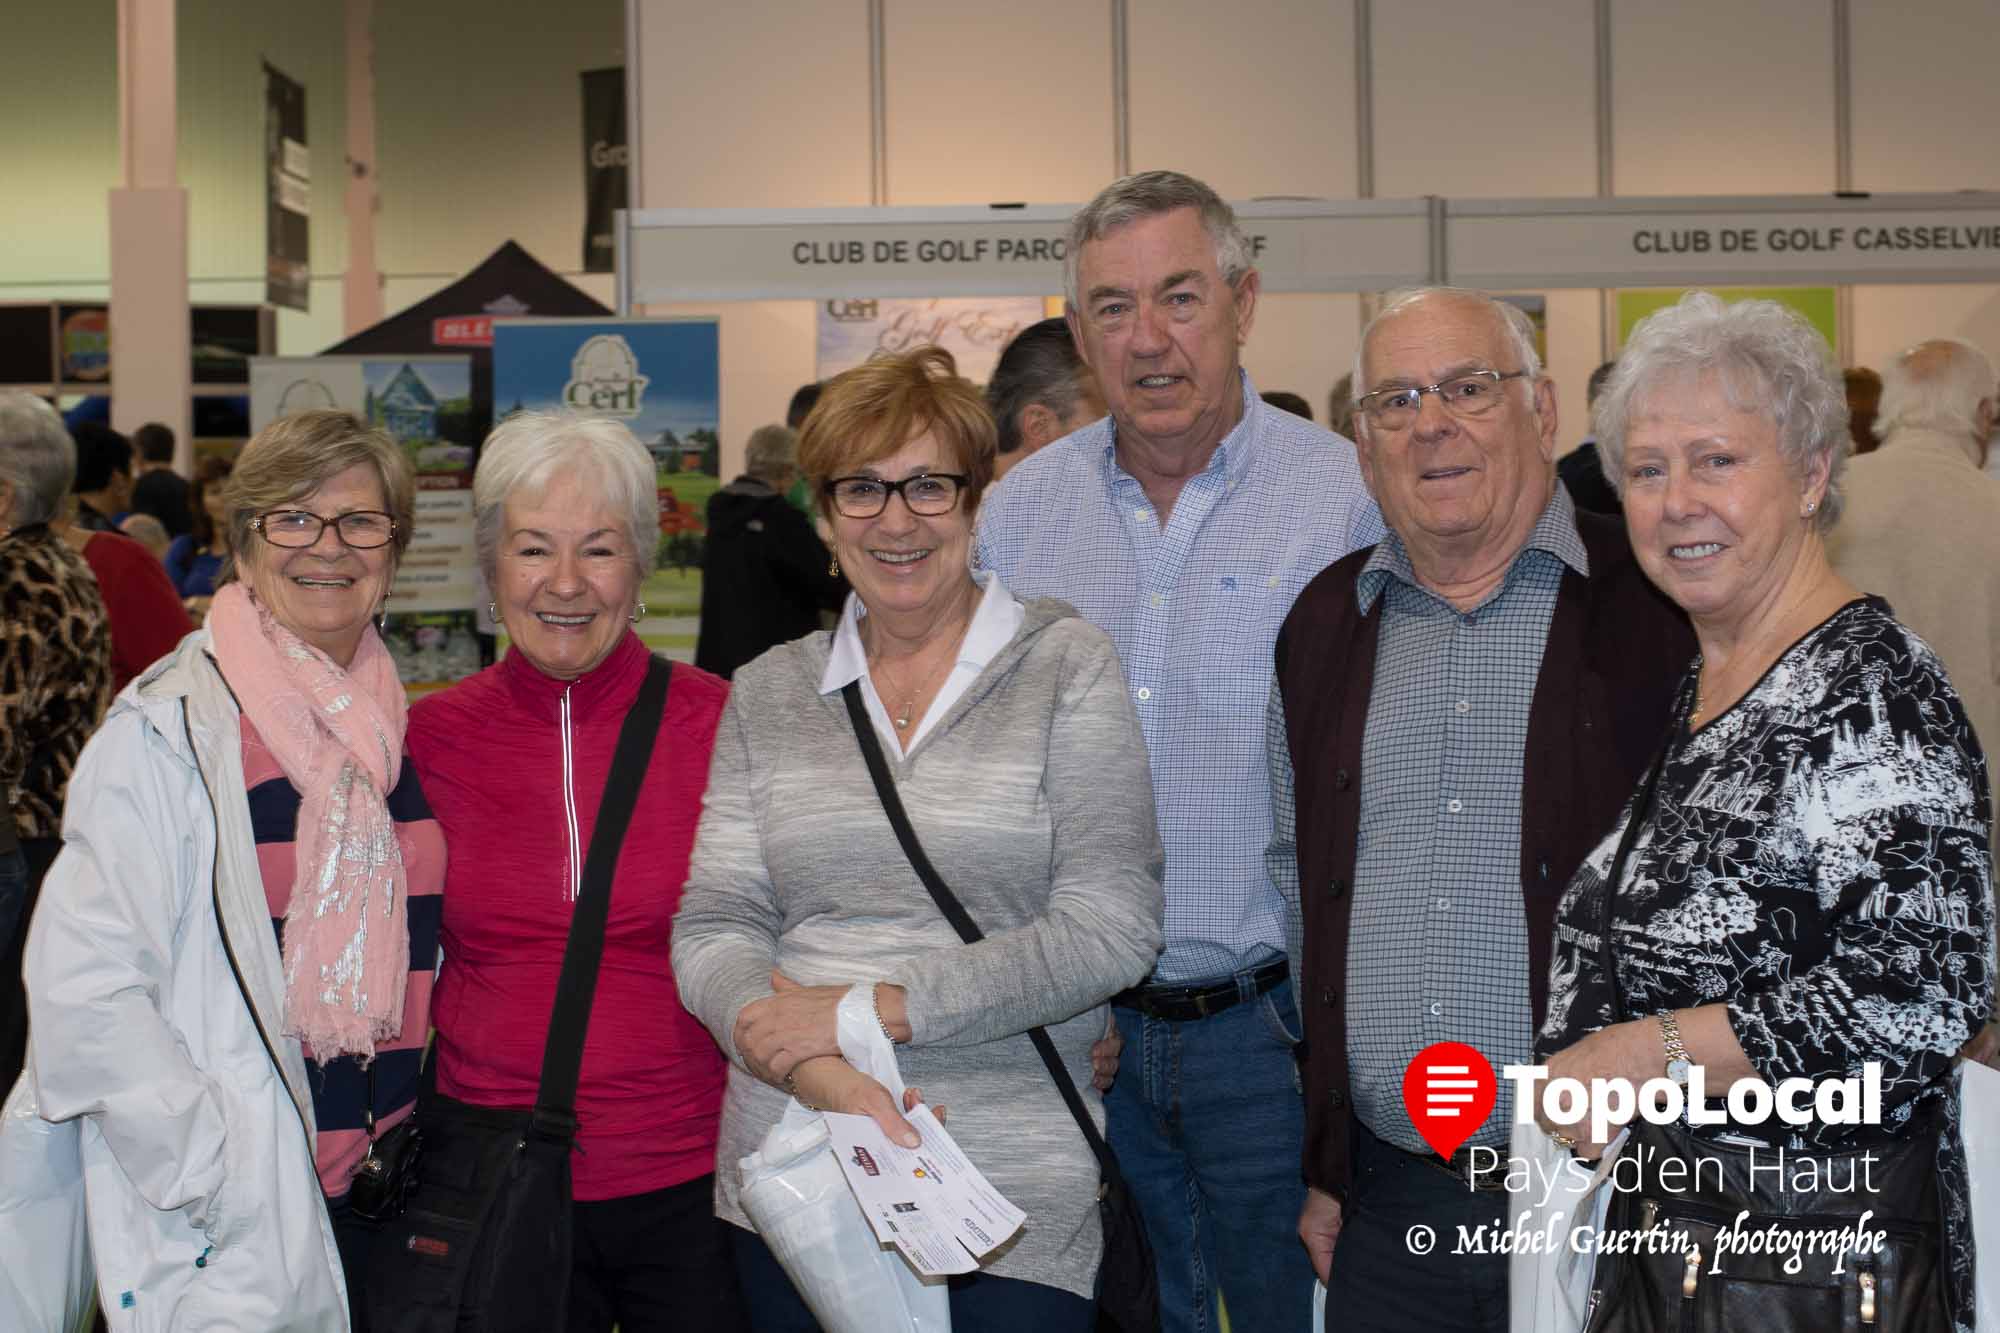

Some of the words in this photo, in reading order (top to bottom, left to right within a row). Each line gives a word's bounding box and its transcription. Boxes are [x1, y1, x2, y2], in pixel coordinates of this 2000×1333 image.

[793, 241, 865, 264] CLUB
[873, 240, 909, 263] DE
[917, 239, 988, 263] GOLF
[997, 238, 1067, 262] PARC
[1633, 230, 1711, 254] CLUB
[1720, 229, 1758, 252] DE
[1768, 228, 1843, 252] GOLF
[568, 379, 646, 410] Cerf
